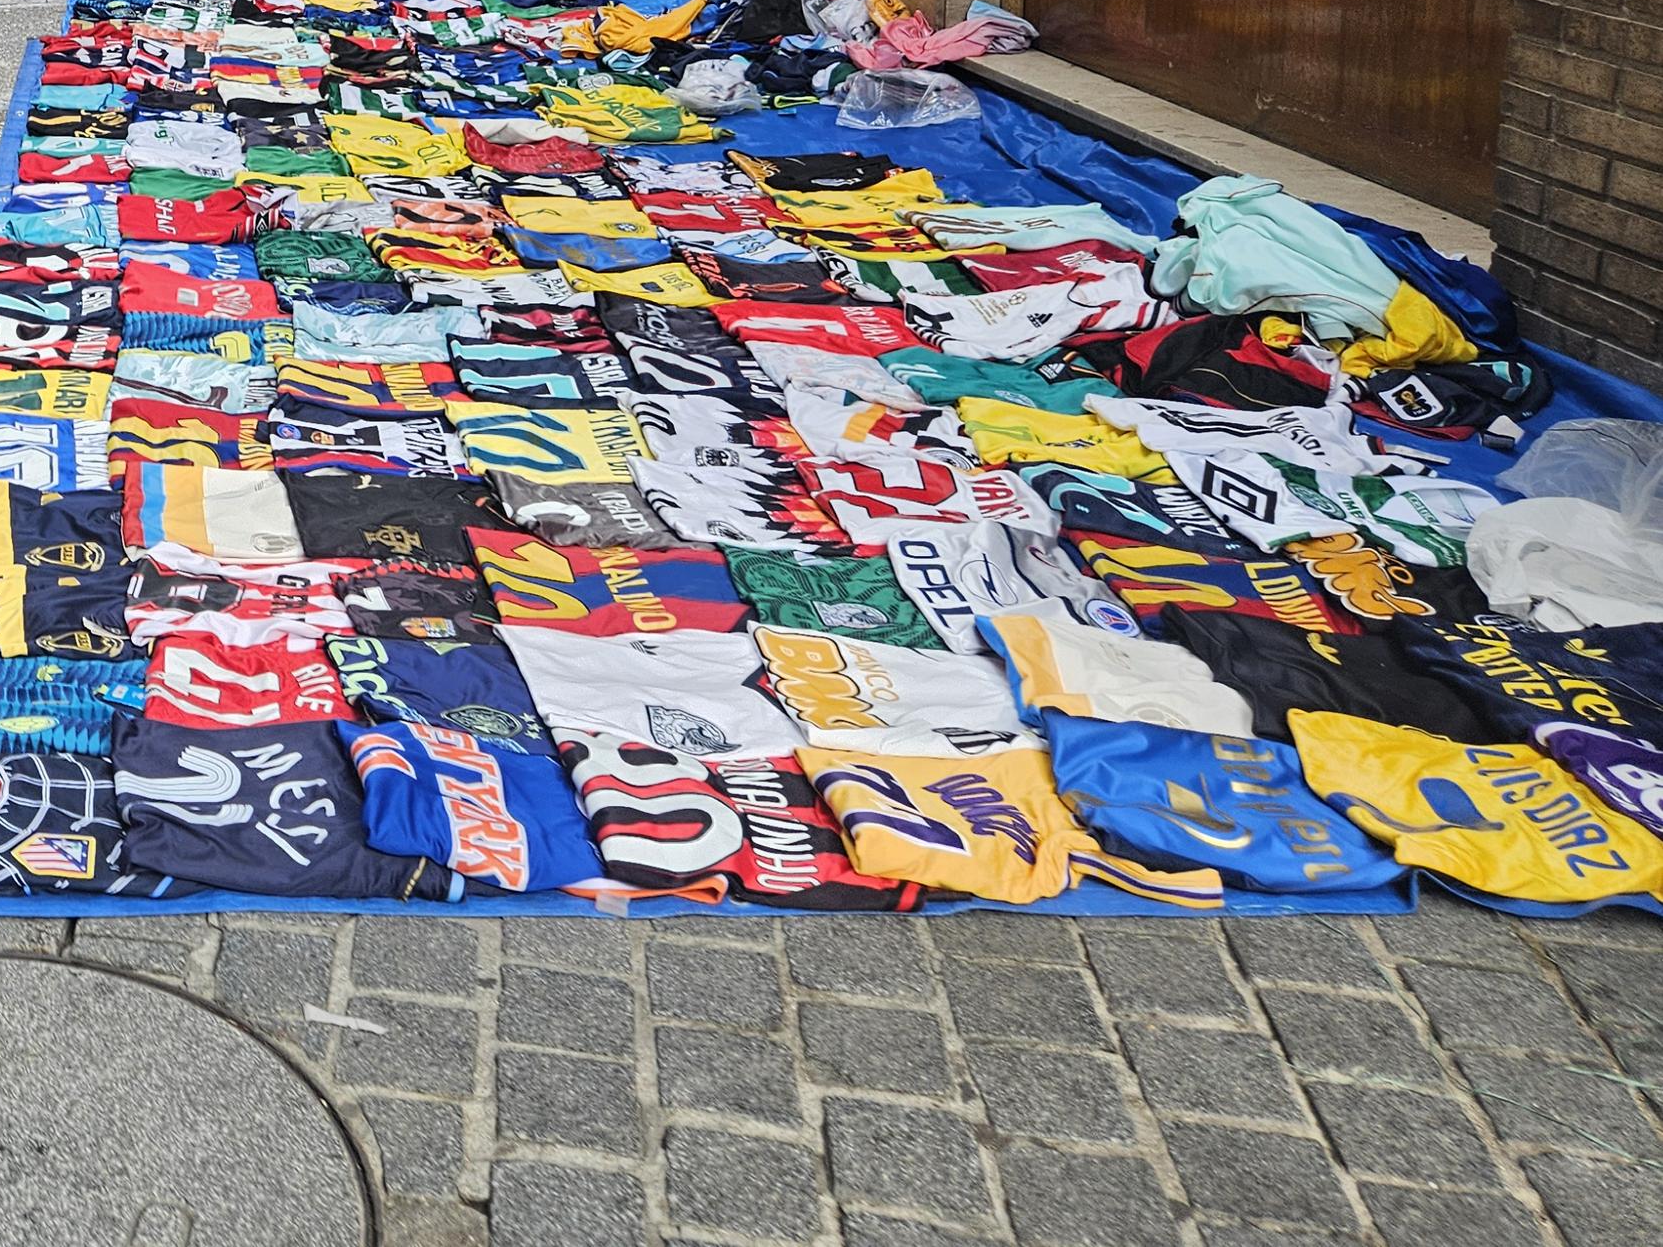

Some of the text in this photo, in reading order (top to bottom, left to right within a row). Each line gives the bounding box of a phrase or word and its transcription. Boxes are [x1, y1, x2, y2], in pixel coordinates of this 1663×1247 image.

[897, 539, 975, 629] OPEL
[291, 661, 335, 715] RICE
[845, 643, 899, 702] BANCO
[230, 742, 338, 867] MESSI
[1543, 787, 1632, 880] DIAZ
